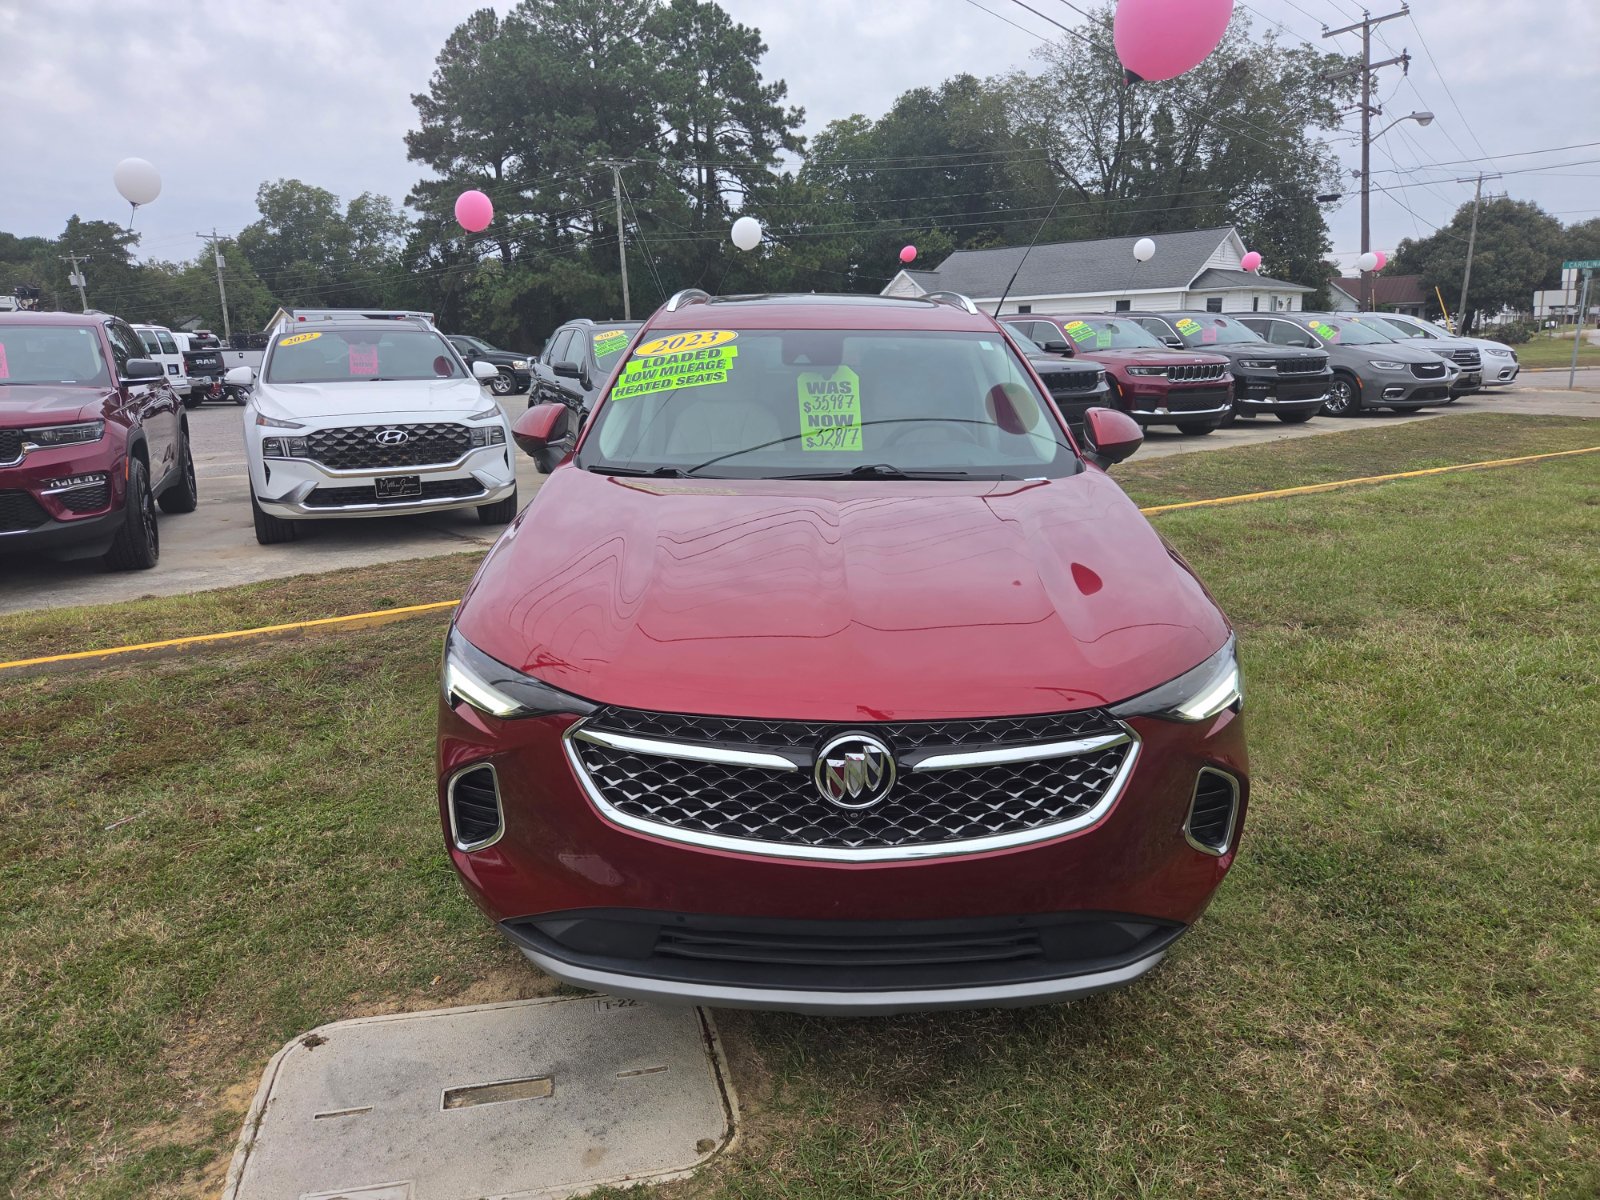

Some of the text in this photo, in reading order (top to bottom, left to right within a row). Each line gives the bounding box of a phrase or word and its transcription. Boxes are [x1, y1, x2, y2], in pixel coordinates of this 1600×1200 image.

[287, 333, 315, 345] 2022
[651, 330, 720, 354] 2023
[642, 348, 722, 369] LOADED
[624, 358, 726, 384] LOW MILEAGE
[613, 371, 725, 398] HEATED SEATS
[806, 381, 853, 394] WAS
[807, 414, 854, 427] NOW
